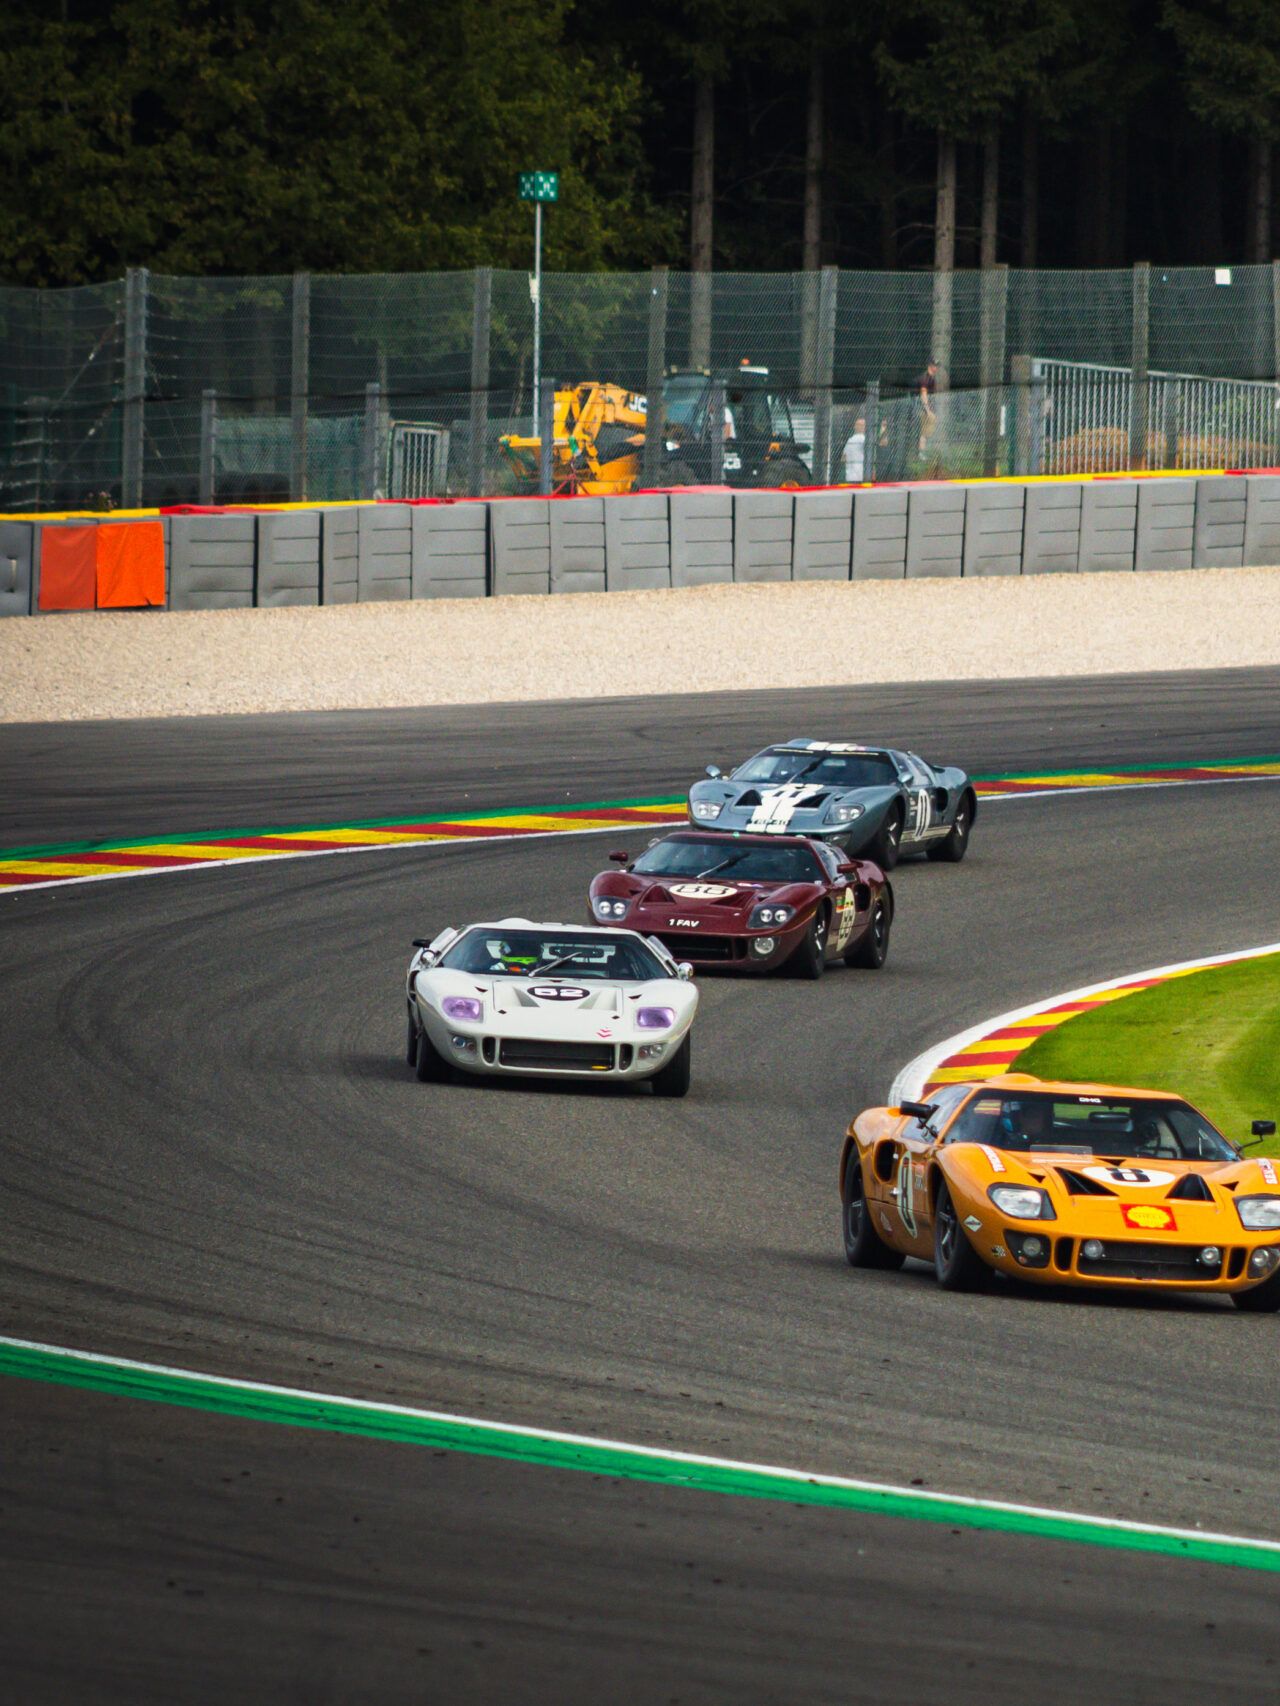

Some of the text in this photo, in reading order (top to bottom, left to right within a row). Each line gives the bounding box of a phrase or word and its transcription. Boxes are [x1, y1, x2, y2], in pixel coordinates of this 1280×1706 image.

[629, 394, 647, 413] JC
[676, 919, 700, 928] FAV
[534, 987, 583, 997] 52
[1105, 1167, 1151, 1183] 8
[901, 1156, 915, 1230] 8
